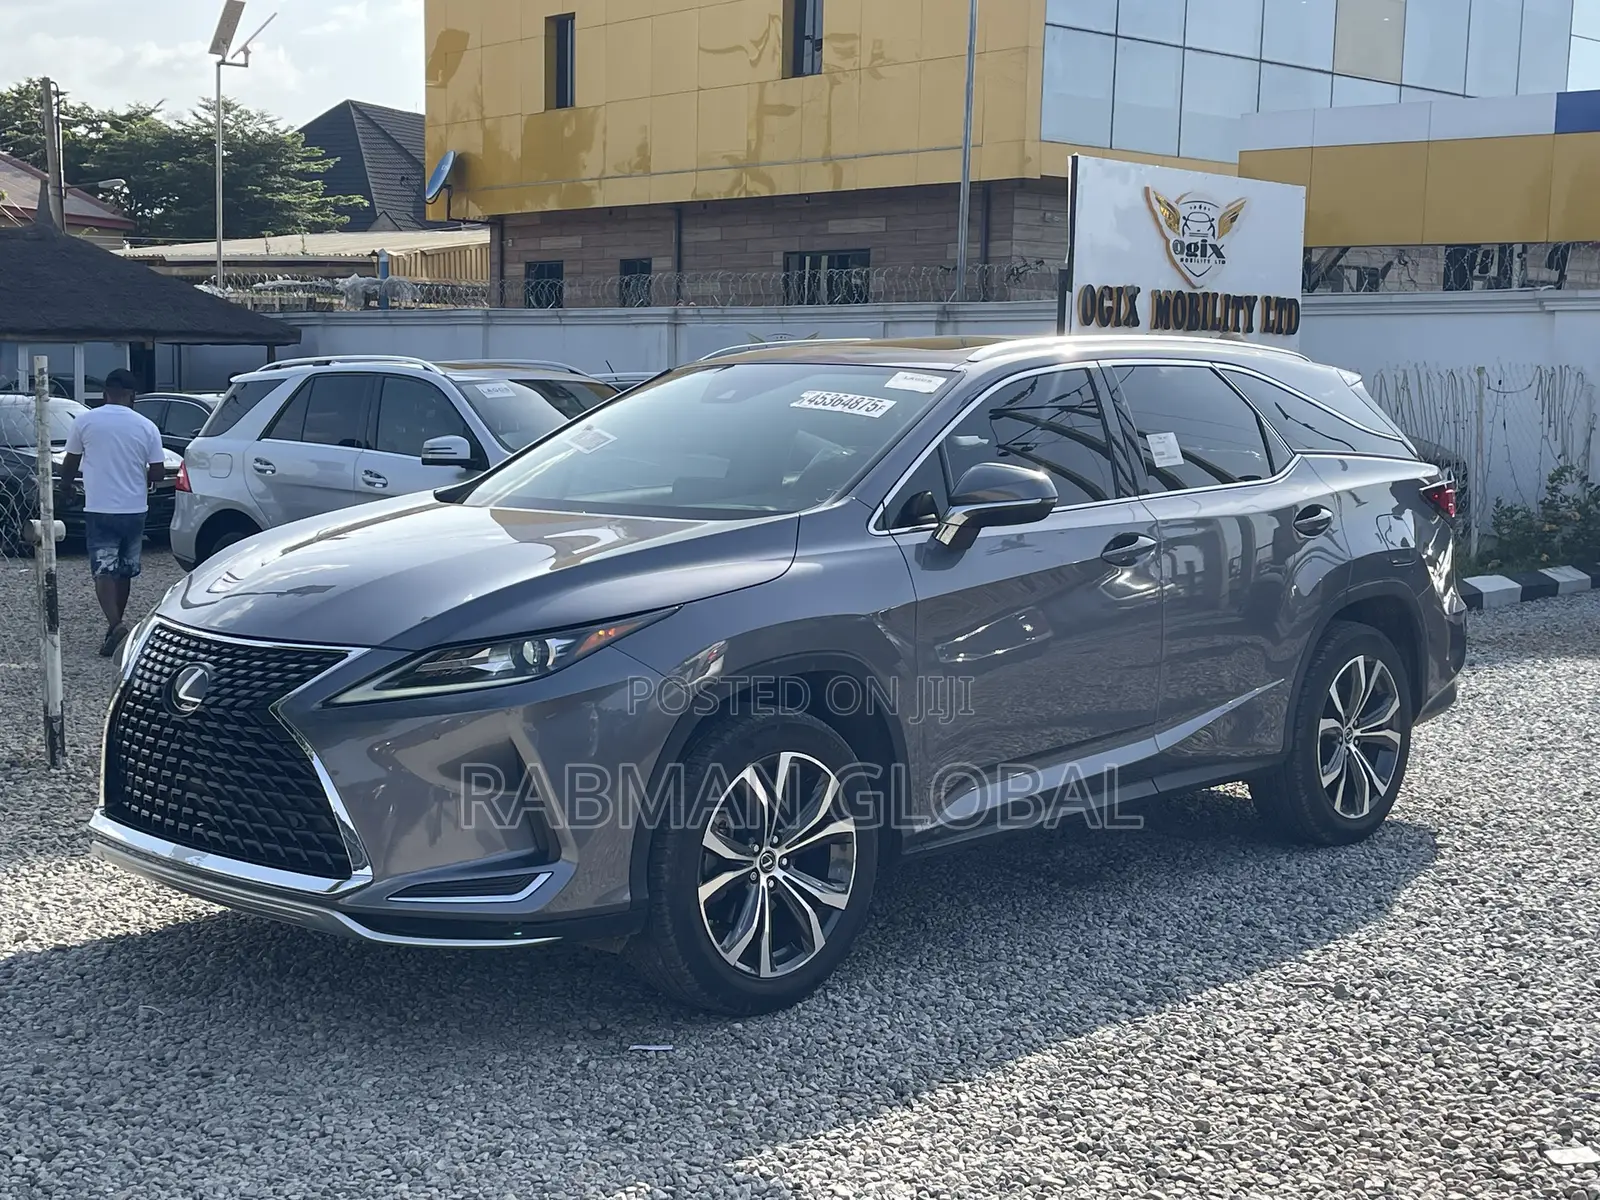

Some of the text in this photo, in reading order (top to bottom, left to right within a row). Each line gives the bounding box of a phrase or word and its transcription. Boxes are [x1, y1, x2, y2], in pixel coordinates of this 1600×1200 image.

[1180, 257, 1211, 265] MOBILITY
[1077, 283, 1301, 336] OGIX MOBILITY LTD
